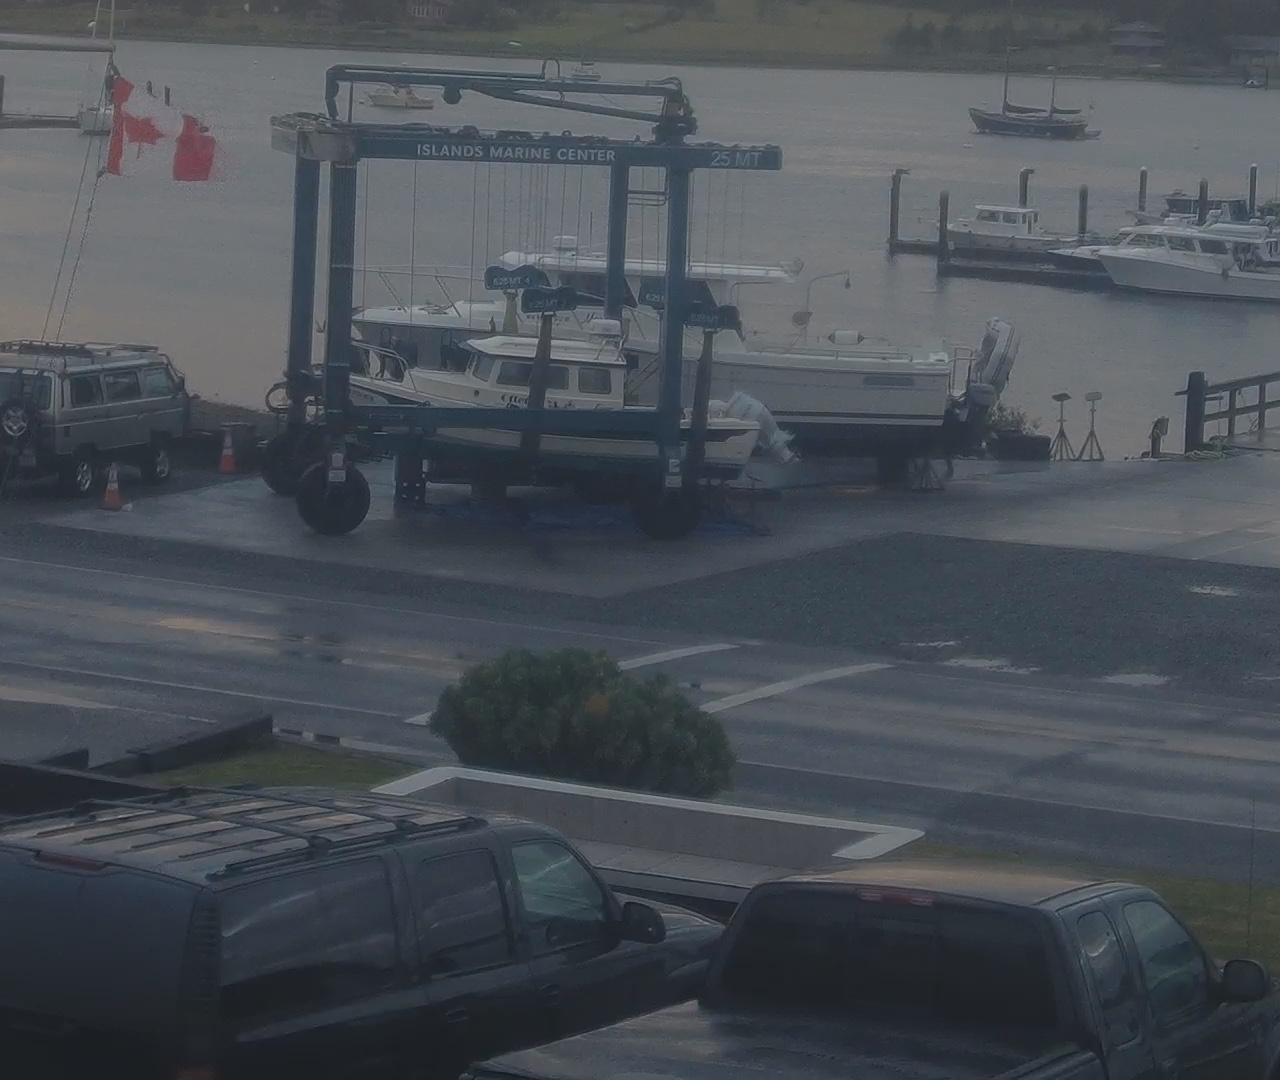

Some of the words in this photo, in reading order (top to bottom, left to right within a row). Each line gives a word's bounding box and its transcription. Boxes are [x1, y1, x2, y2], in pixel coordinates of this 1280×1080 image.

[416, 143, 484, 158] ISLANDS
[489, 145, 551, 160] MARINE
[557, 148, 616, 162] CENTER
[711, 151, 731, 166] 25
[735, 152, 763, 167] MT
